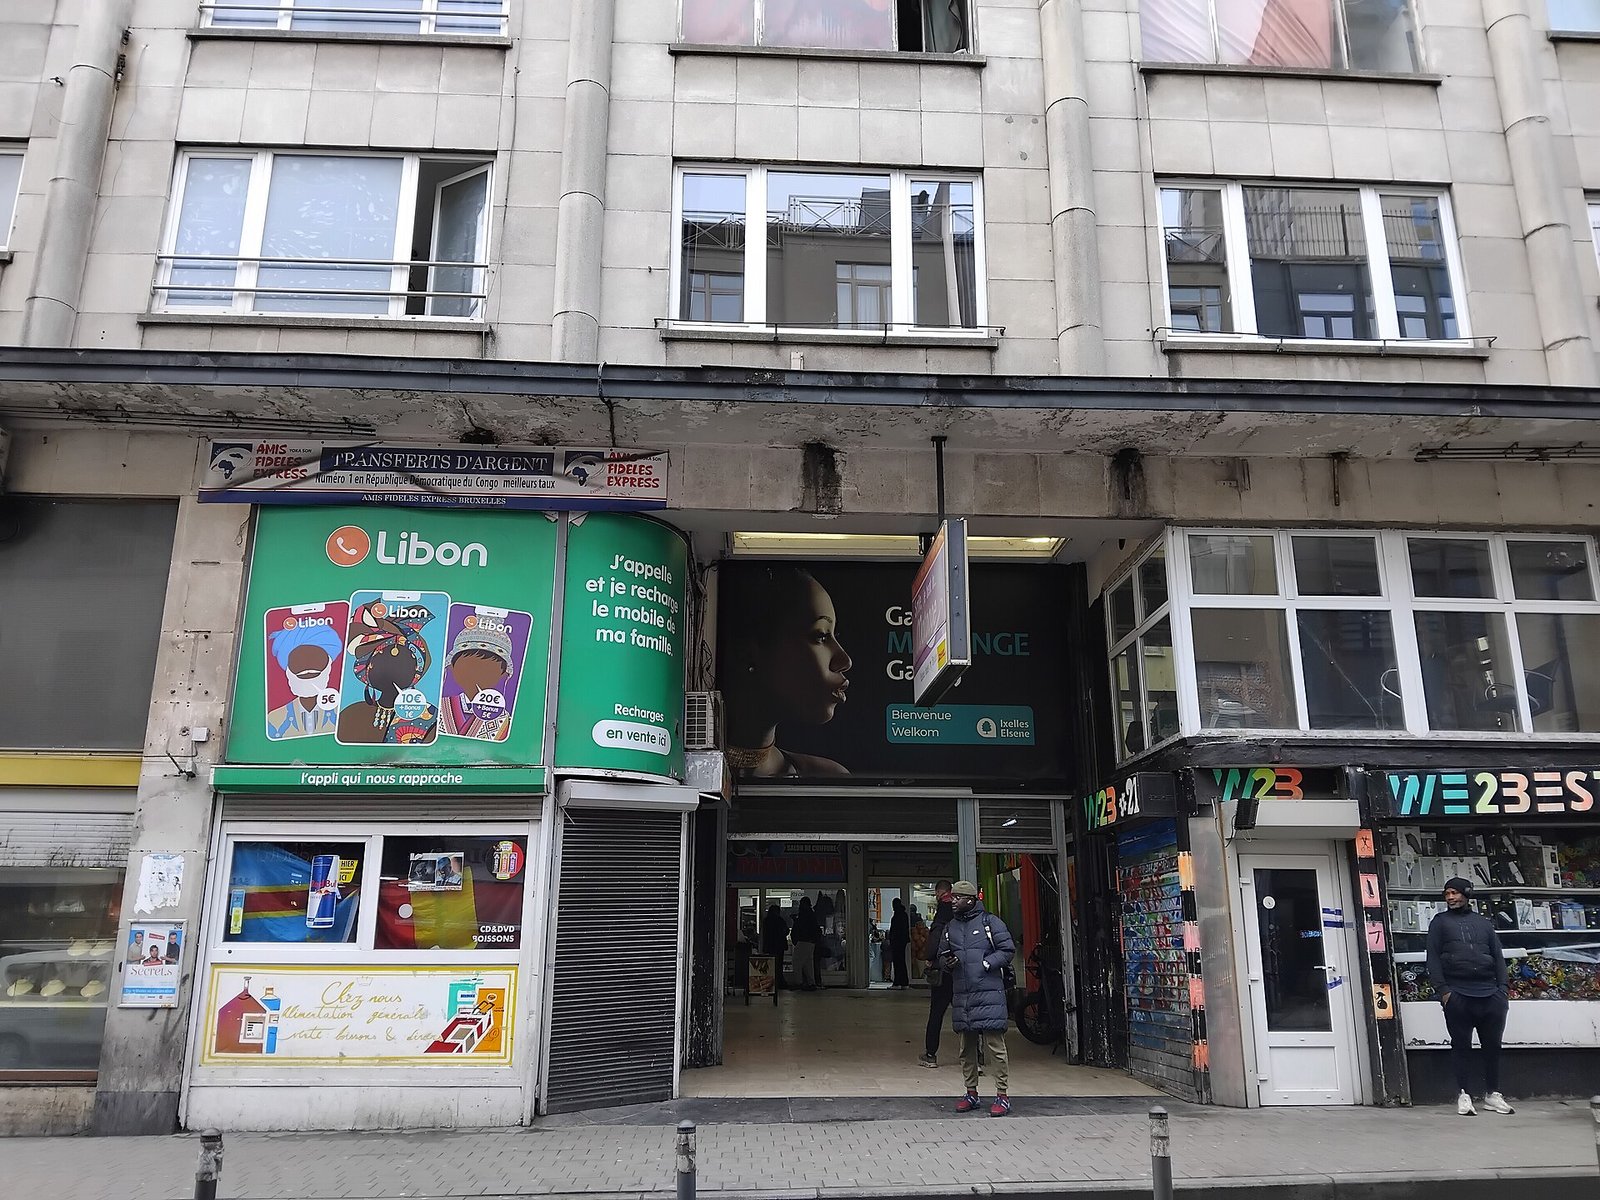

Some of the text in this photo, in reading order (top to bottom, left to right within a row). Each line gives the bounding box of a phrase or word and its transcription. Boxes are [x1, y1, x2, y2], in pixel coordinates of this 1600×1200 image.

[256, 444, 288, 455] AMIS
[255, 456, 302, 467] FIDELES
[332, 452, 451, 469] TRANSFERTS
[455, 455, 548, 472] D'ARGENT
[253, 468, 308, 480] EXPRESS
[607, 463, 653, 476] FIDELES
[315, 472, 556, 490] Numéro 1 en République Démocratique du Congo meilleurs taux
[606, 476, 660, 488] EXPRESS
[375, 531, 488, 567] Libon
[609, 554, 673, 585] J'appelle
[585, 576, 679, 614] et je recharge
[388, 604, 428, 619] Libon
[592, 600, 676, 635] le mobile de
[298, 617, 334, 629] Libon
[479, 618, 513, 634] Libon
[596, 628, 674, 656] ma famille.
[321, 694, 336, 704] 5€
[401, 693, 422, 703] 10€
[479, 693, 501, 704] 20€
[614, 703, 664, 723] Recharges
[891, 709, 952, 721] Bienvenue
[1000, 719, 1029, 729] Ixelles
[606, 729, 667, 747] en vente ici
[891, 726, 940, 737] Welkom
[1000, 728, 1030, 739] Elsene
[301, 772, 463, 786] l'appli qui nous rapproche
[1119, 776, 1140, 817] #21
[340, 860, 355, 868] HIER
[480, 925, 515, 933] CD&DVD
[321, 981, 403, 1011] Chez nous
[281, 1005, 354, 1020] Alimentation
[385, 1026, 395, 1041] &
